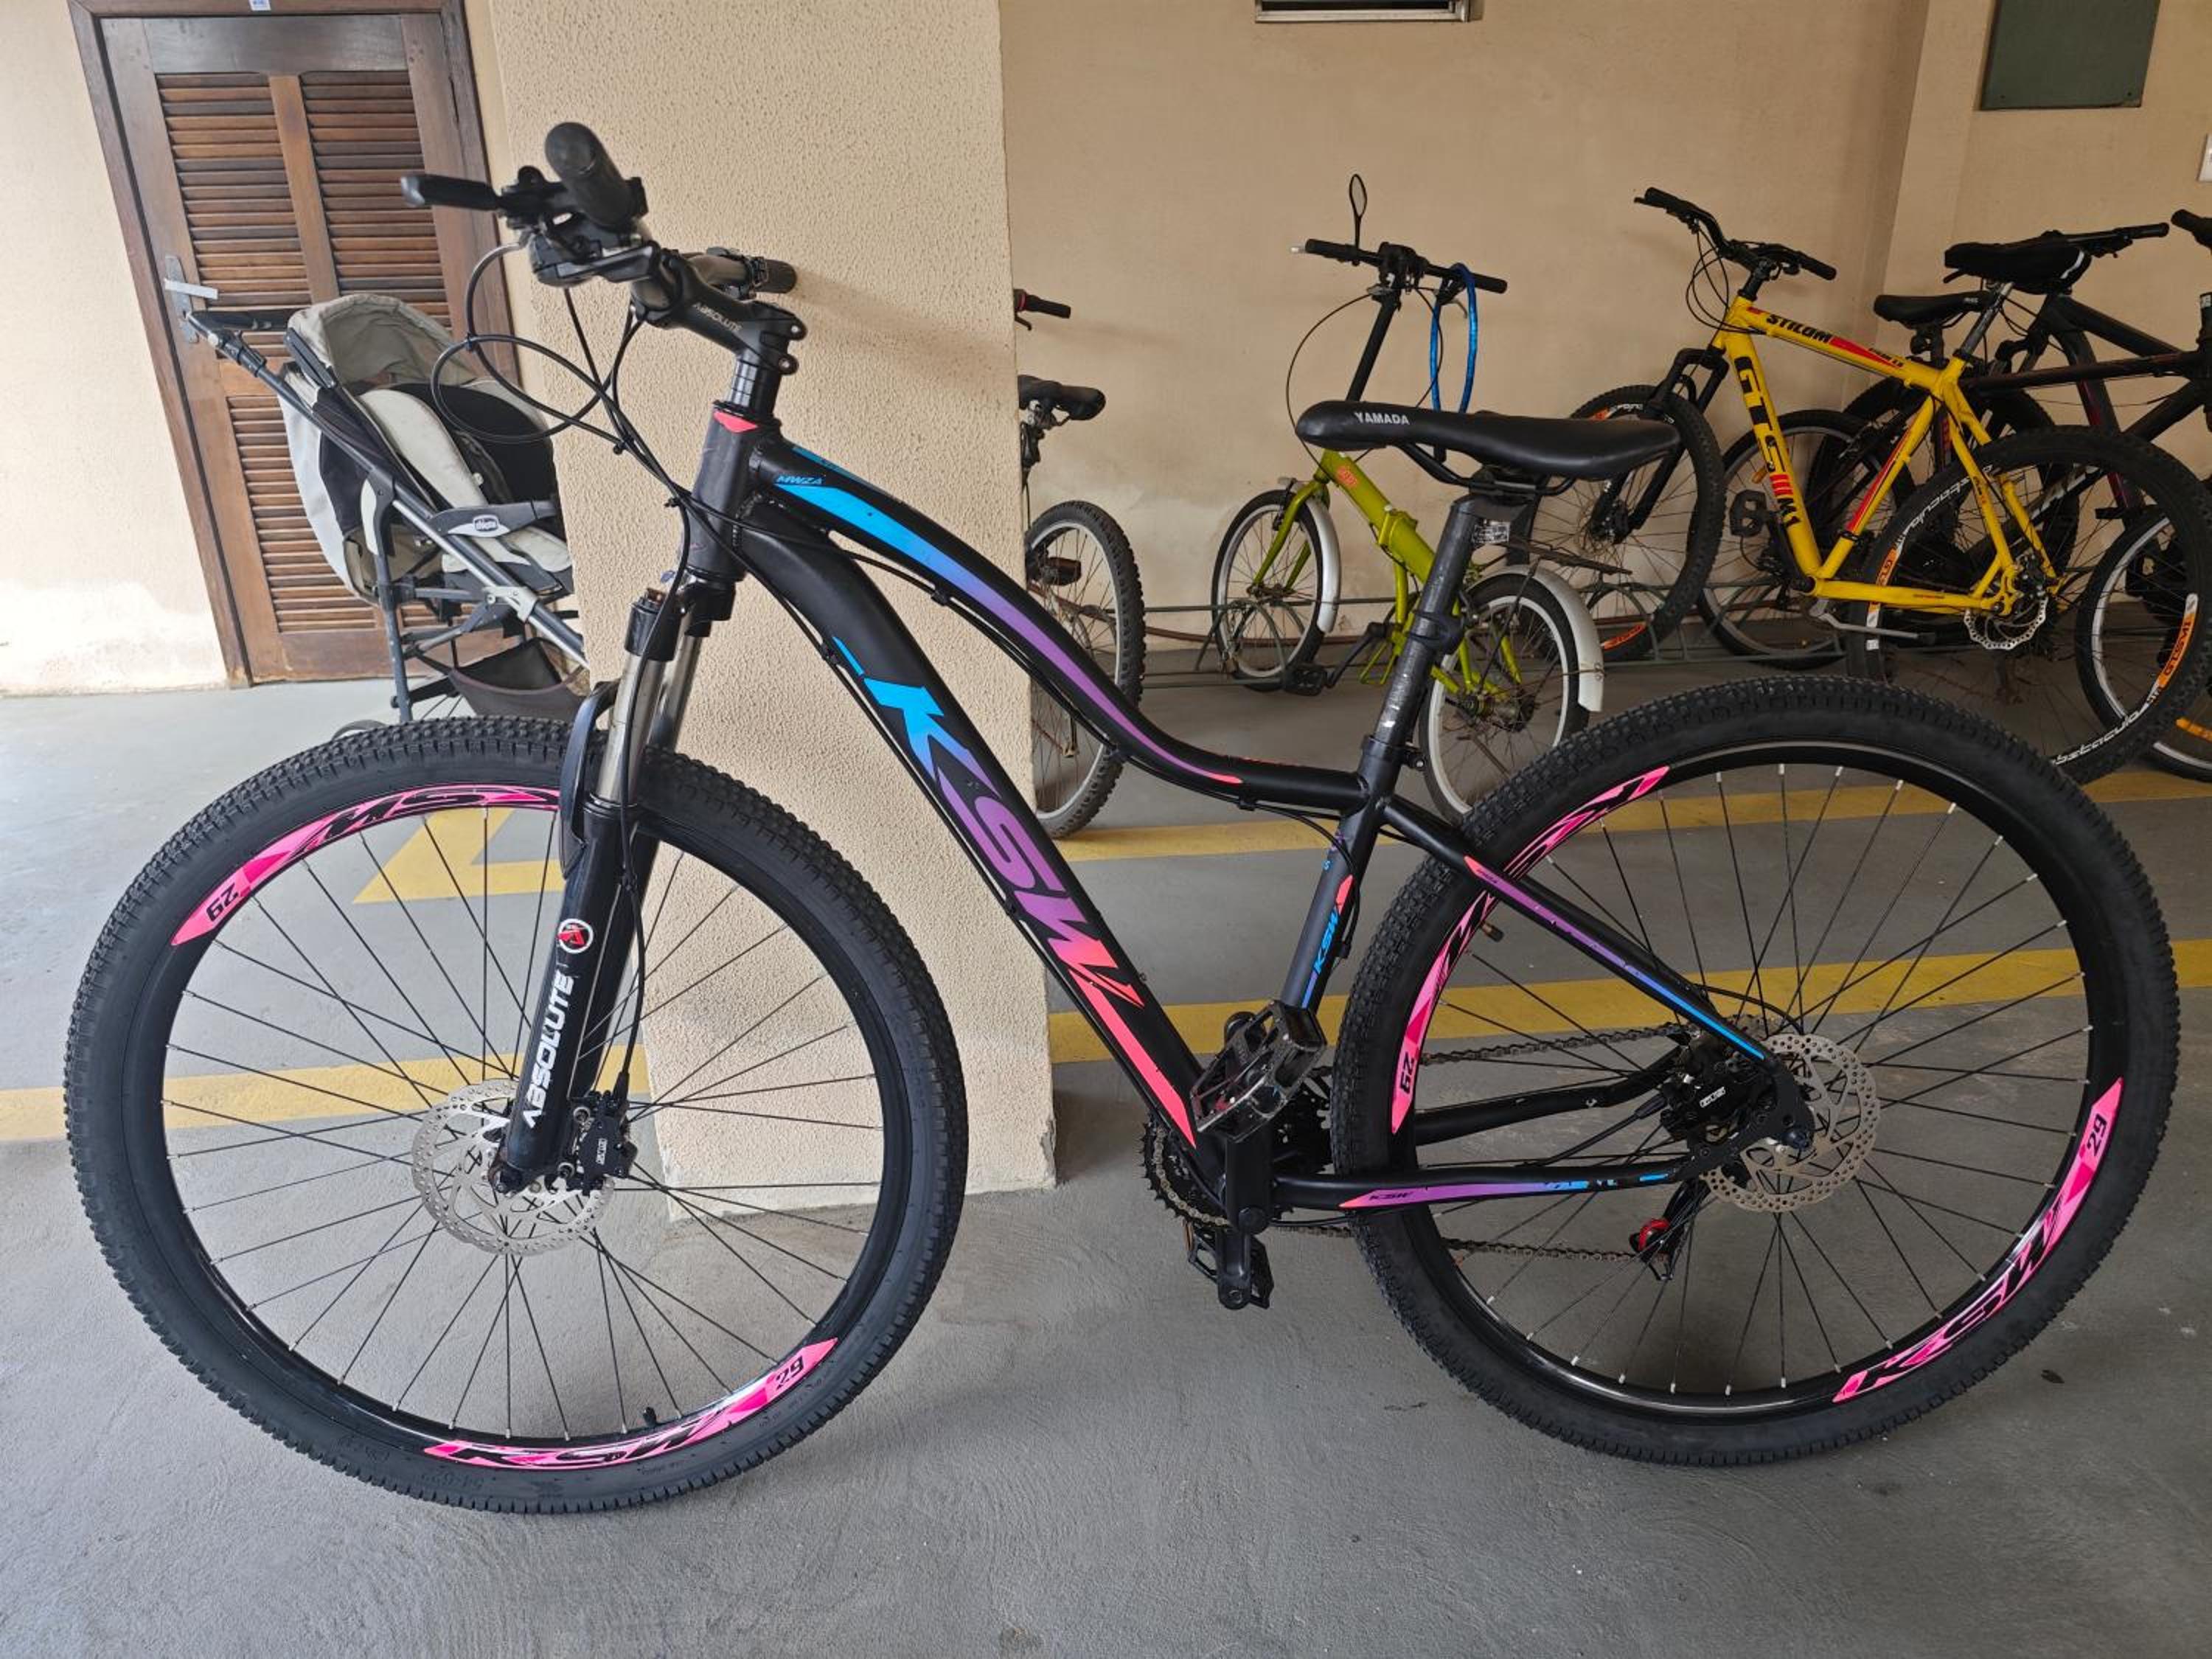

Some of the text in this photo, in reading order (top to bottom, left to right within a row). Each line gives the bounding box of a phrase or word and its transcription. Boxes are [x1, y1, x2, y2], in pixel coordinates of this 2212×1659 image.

[1354, 411, 1411, 425] YAMADA
[206, 882, 240, 922] 29
[521, 970, 575, 1130] ABSOLUTE
[1399, 1050, 1416, 1096] 29
[2086, 1112, 2108, 1158] 29
[775, 1355, 804, 1391] 29
